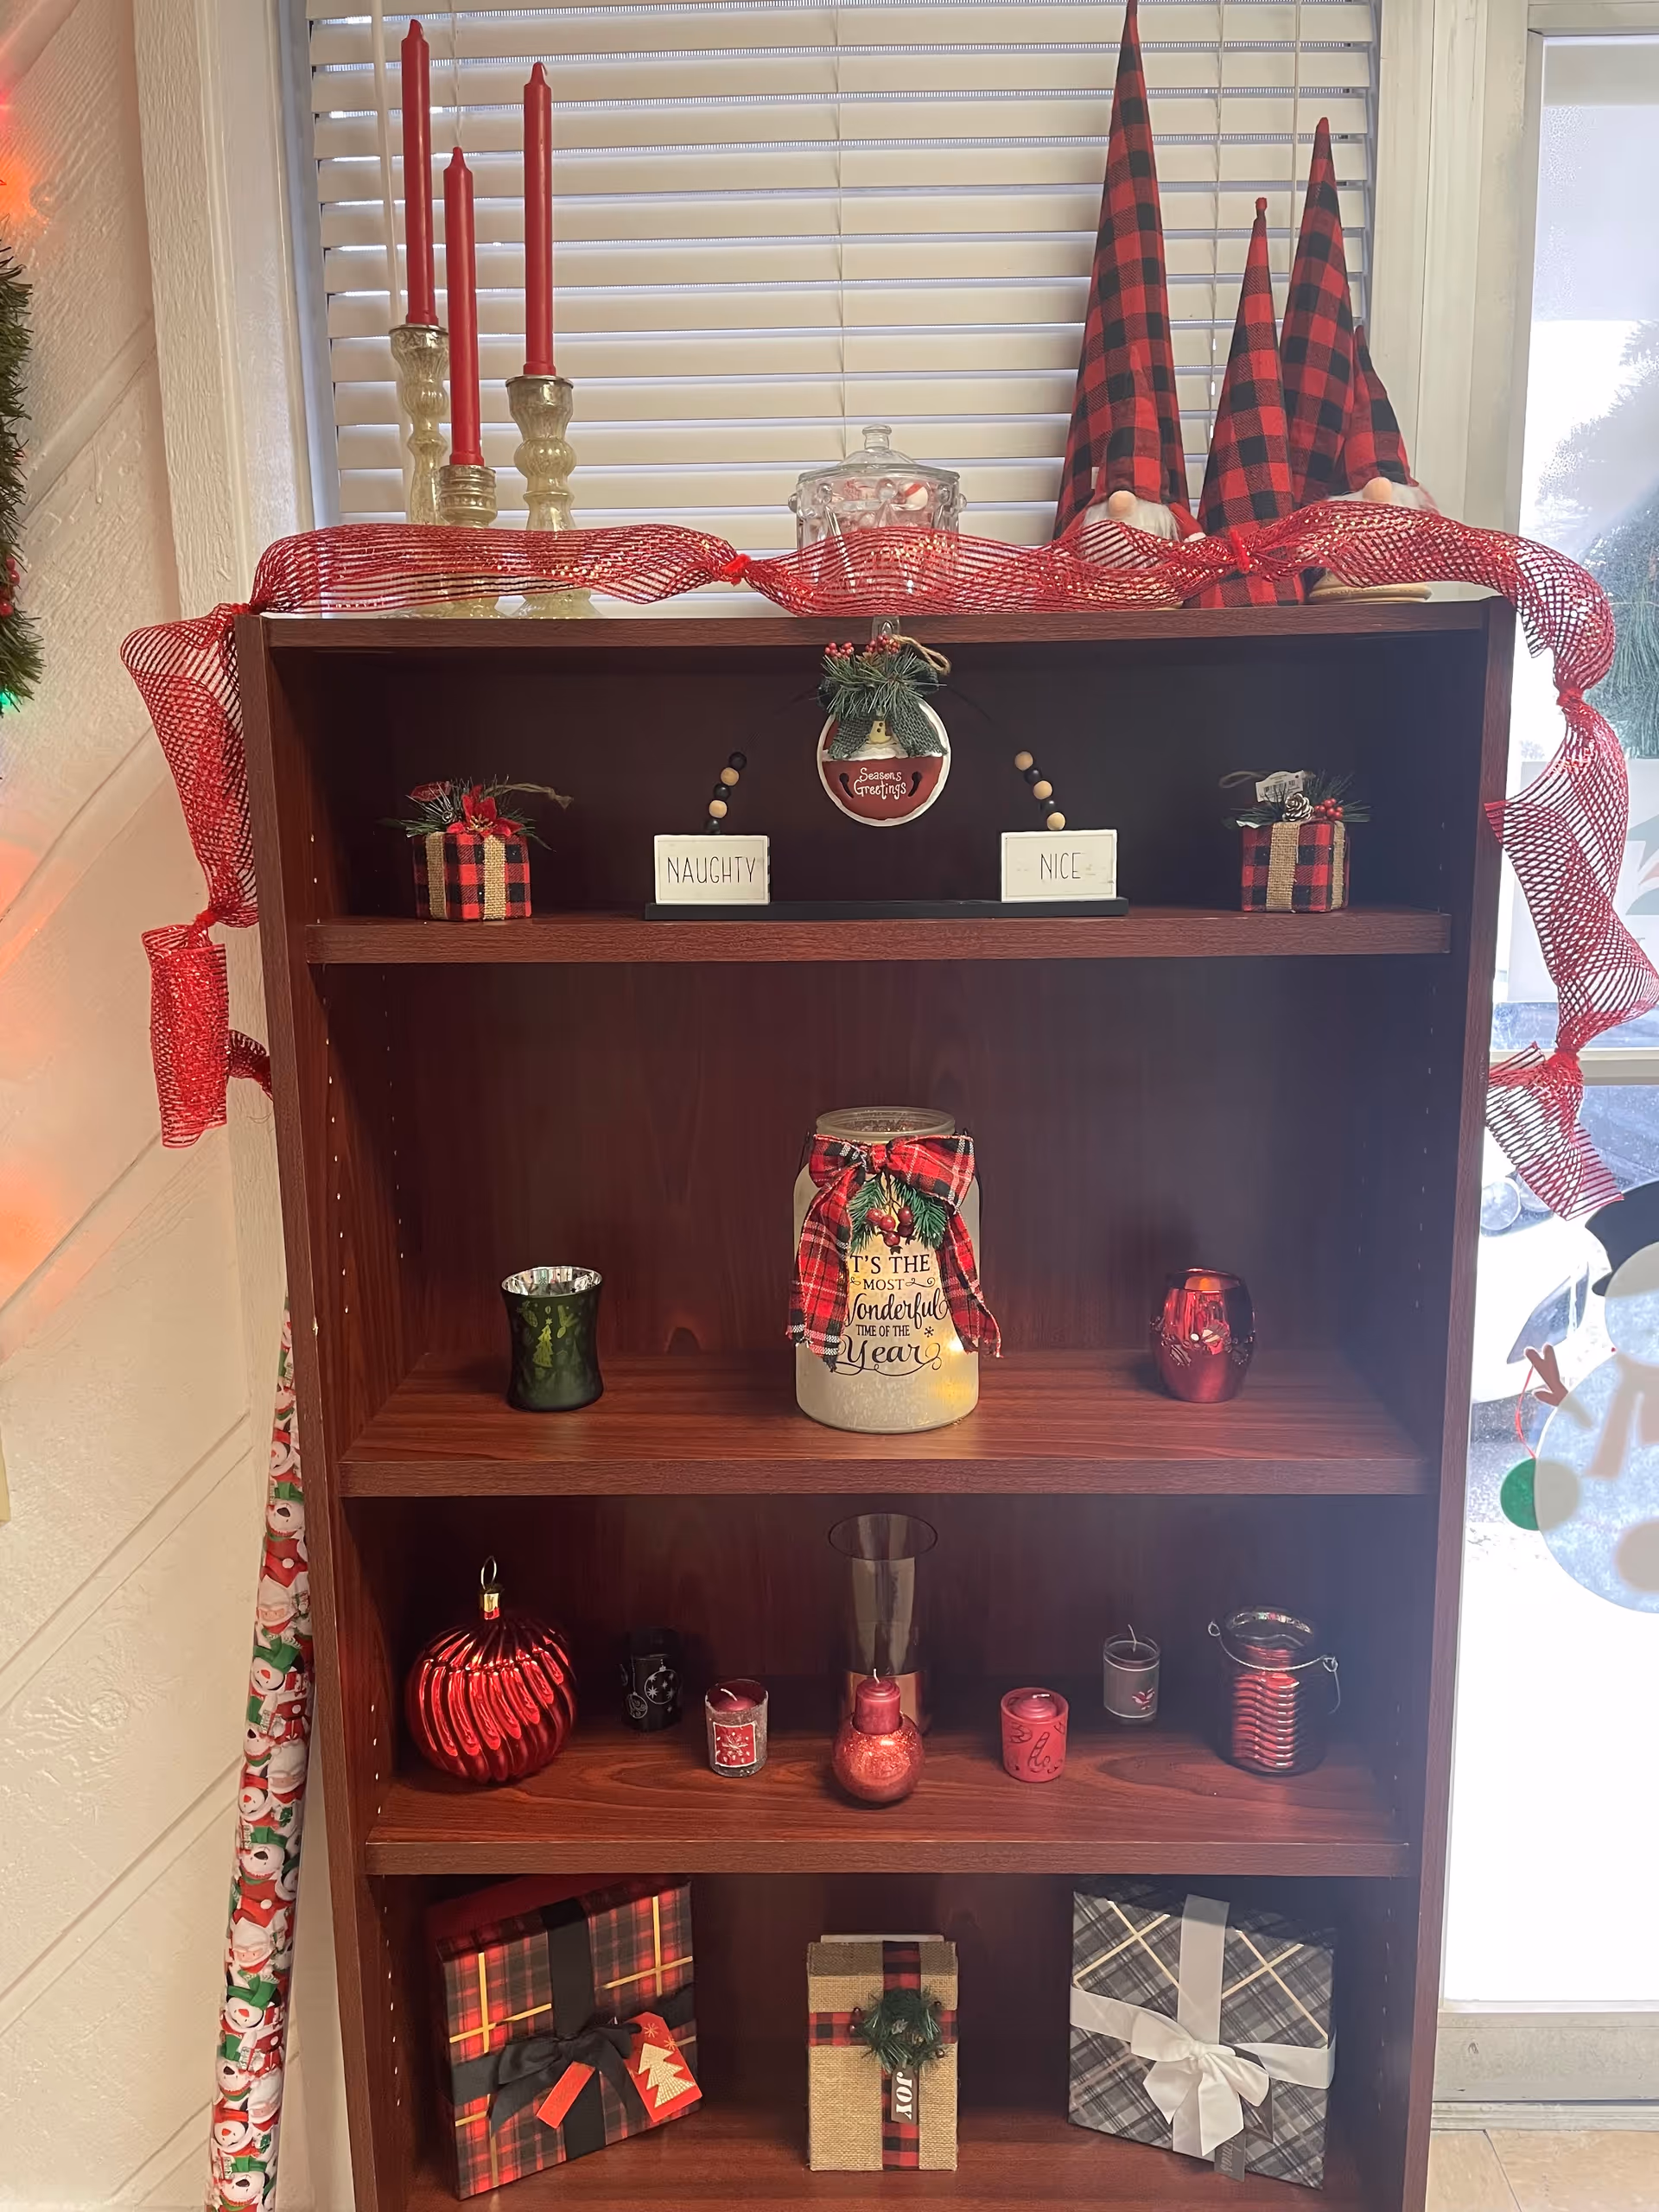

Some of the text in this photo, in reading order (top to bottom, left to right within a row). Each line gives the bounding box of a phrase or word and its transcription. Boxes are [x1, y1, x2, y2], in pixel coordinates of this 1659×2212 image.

[859, 767, 902, 782] Seasons
[854, 779, 907, 800] Greetings
[667, 856, 756, 883] NAUGHTY
[1040, 852, 1082, 880] NICE
[849, 1254, 931, 1274] T'S THE
[862, 1278, 906, 1291] MOST
[855, 1324, 911, 1337] TIME OF THE
[835, 1333, 943, 1376] Year
[895, 2071, 913, 2120] JOY
